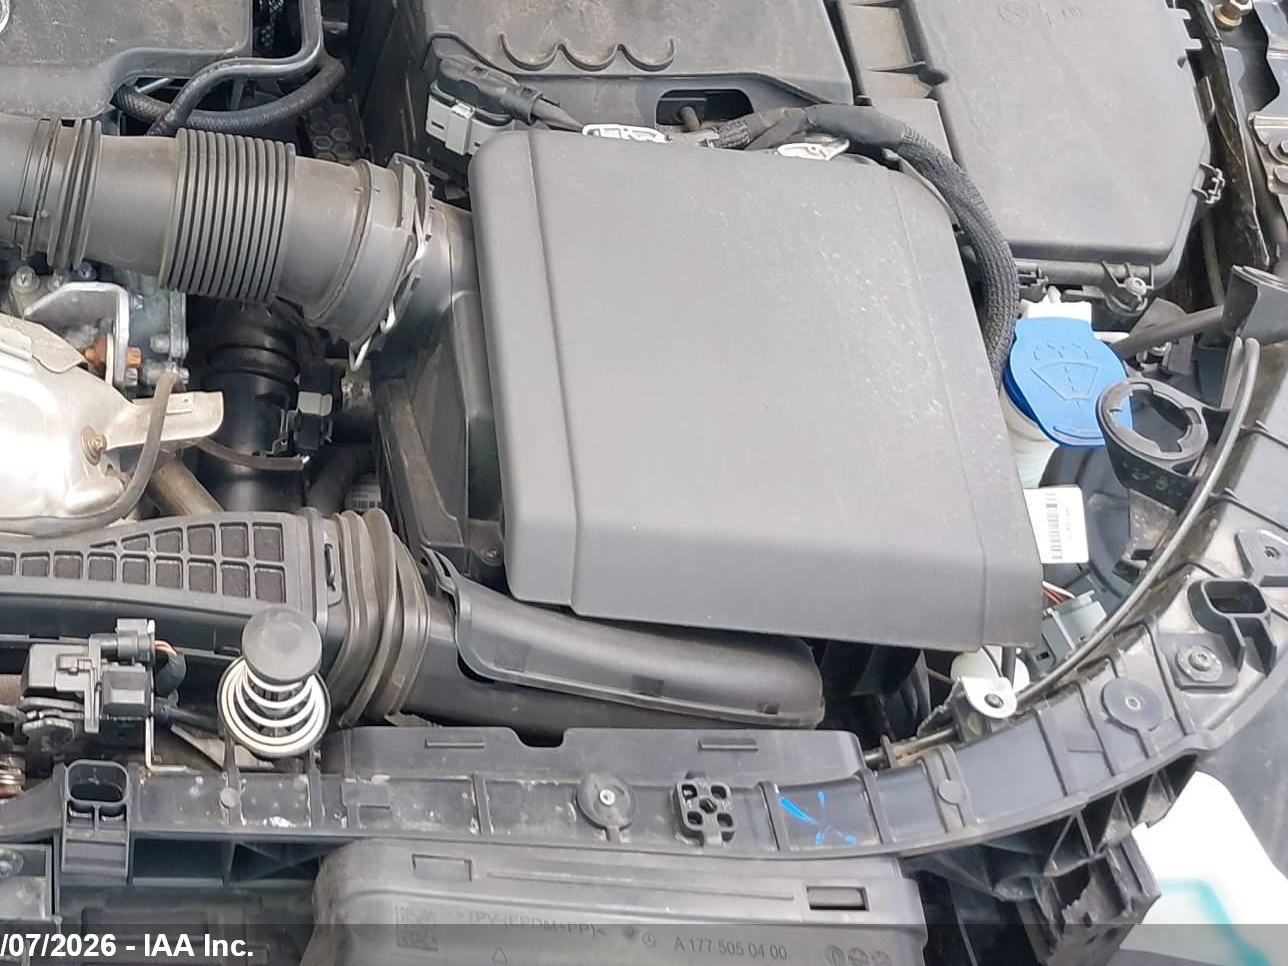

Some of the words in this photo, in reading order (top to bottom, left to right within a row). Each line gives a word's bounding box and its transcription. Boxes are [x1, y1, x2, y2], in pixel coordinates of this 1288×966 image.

[673, 936, 686, 952] A
[689, 937, 712, 954] 177
[718, 940, 745, 957] 505
[748, 942, 766, 959] 04
[770, 944, 788, 961] 00
